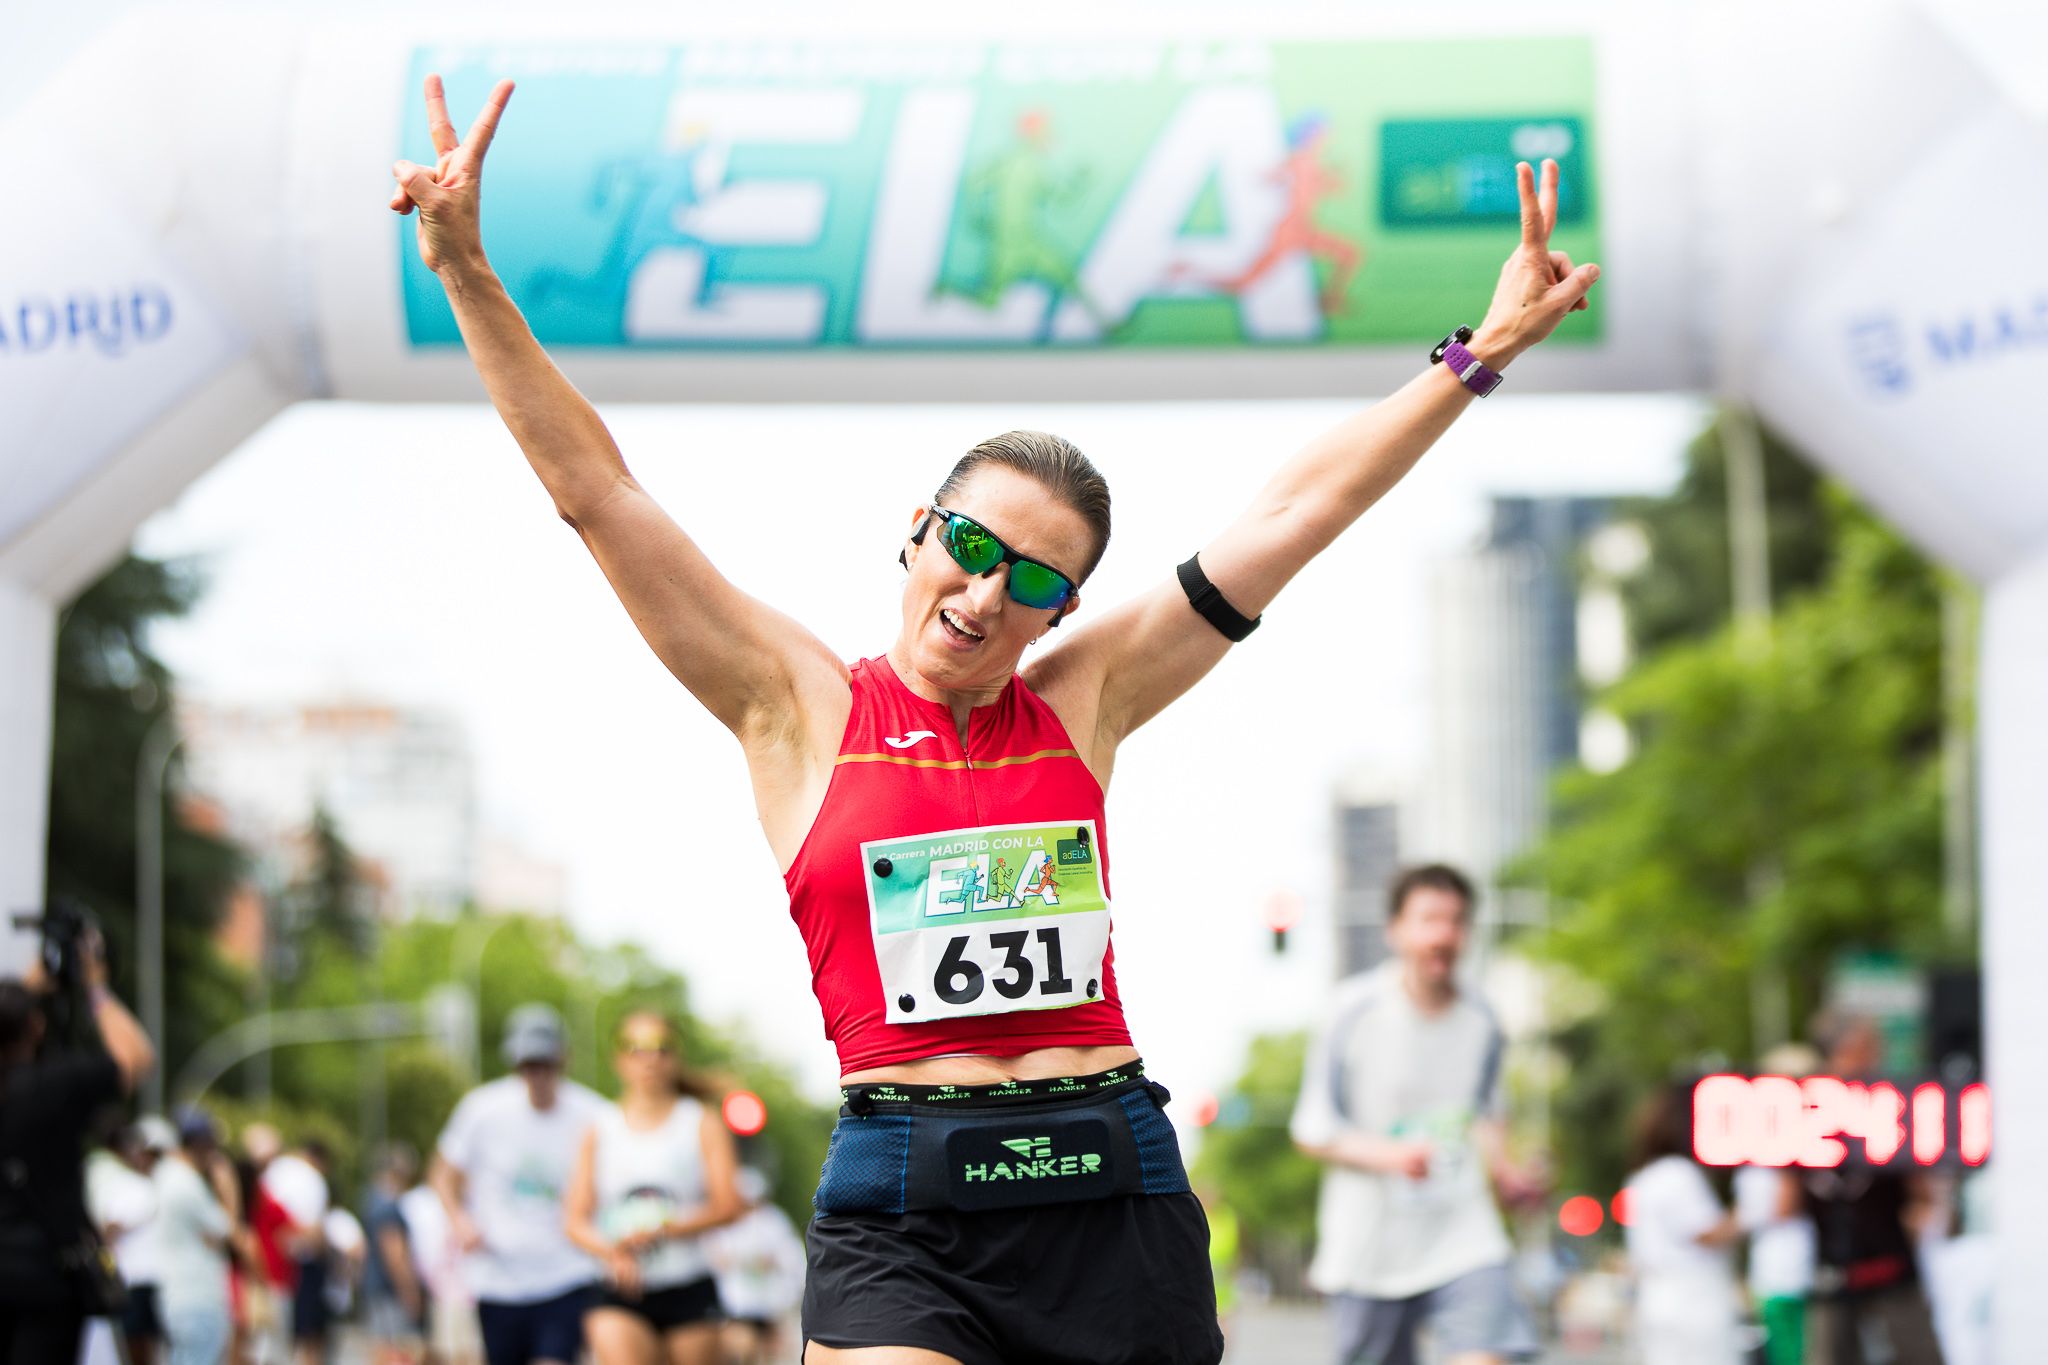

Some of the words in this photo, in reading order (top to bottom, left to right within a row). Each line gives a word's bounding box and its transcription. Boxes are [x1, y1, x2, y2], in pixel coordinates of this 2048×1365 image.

[622, 86, 1327, 344] ELA
[889, 849, 926, 861] Carrera
[929, 840, 989, 858] MADRID
[992, 837, 1023, 850] CON
[1026, 836, 1044, 847] LA
[1062, 849, 1088, 860] adELA
[924, 849, 1060, 918] ELA
[934, 927, 1073, 1005] 631
[928, 1092, 971, 1101] HANKER
[988, 1088, 1032, 1097] HANKER
[1049, 1084, 1087, 1093] HANKER
[1099, 1075, 1129, 1087] HANKER
[965, 1153, 1101, 1183] HANKER
